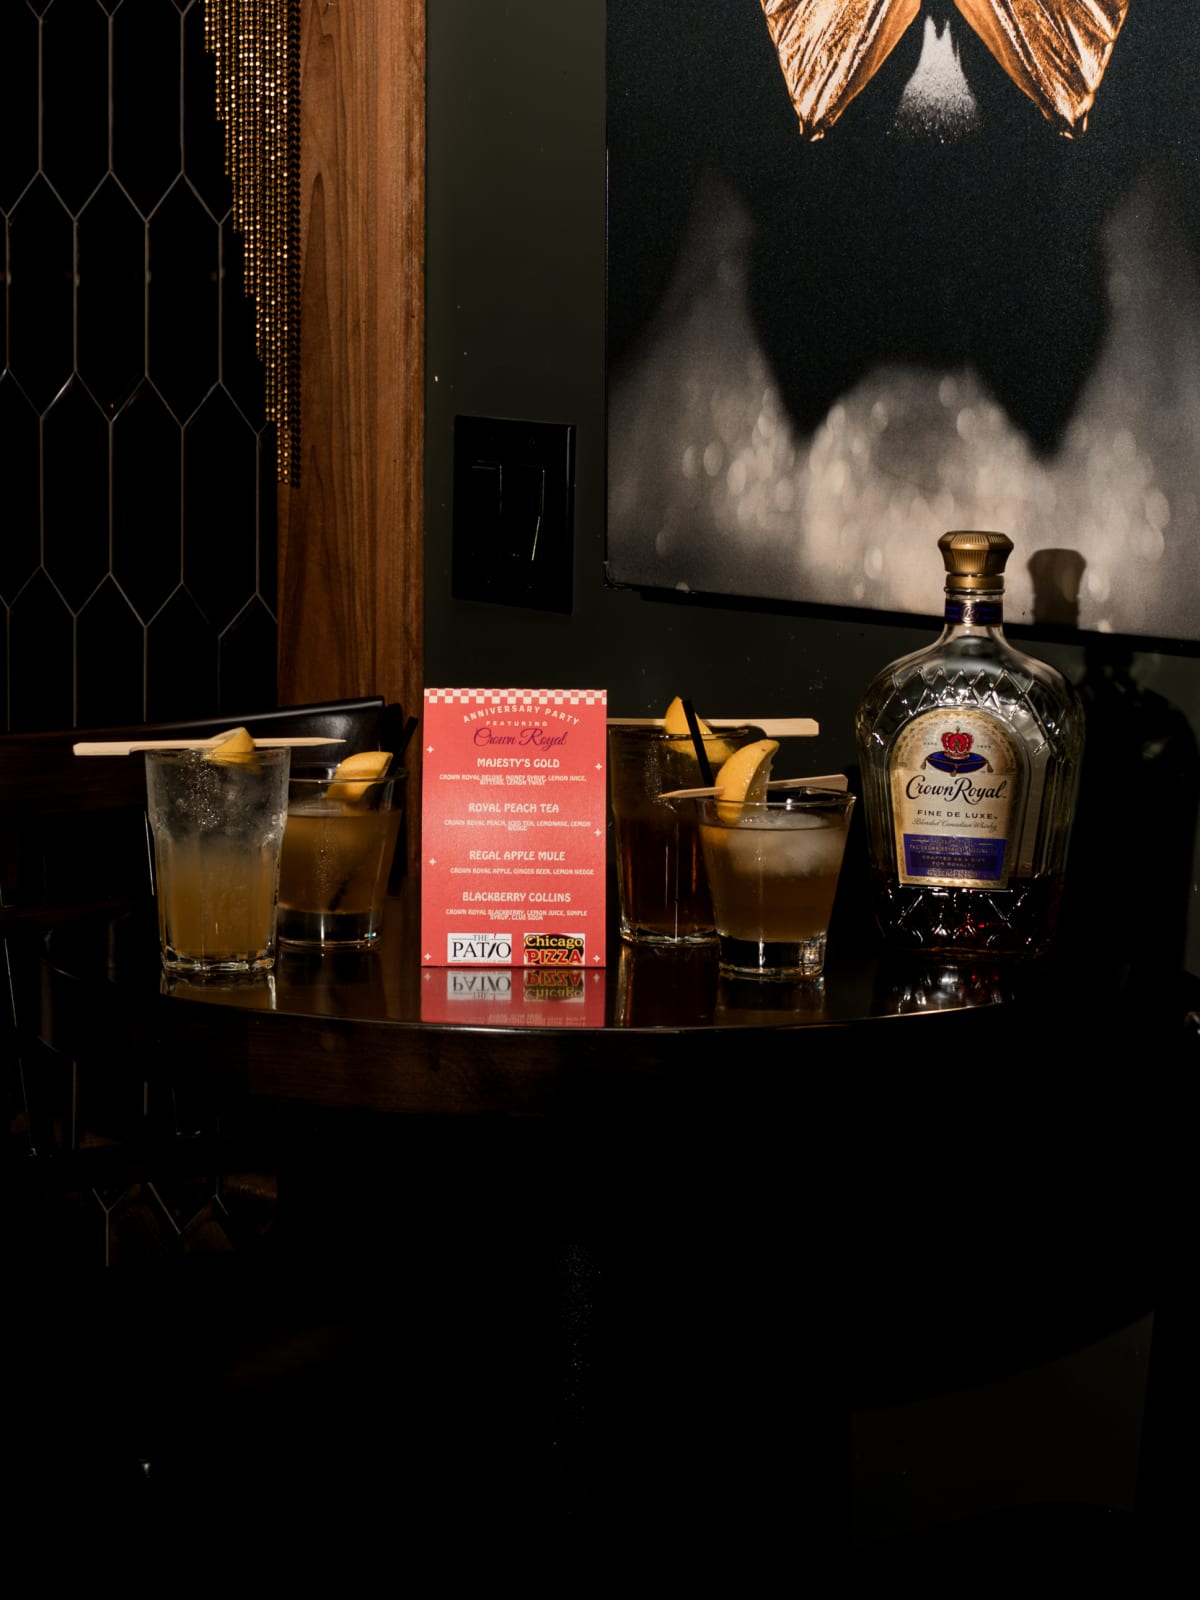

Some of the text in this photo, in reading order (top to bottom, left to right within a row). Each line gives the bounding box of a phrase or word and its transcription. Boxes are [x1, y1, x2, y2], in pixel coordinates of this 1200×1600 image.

[463, 705, 580, 725] ANNIVERSARY PARTY
[474, 728, 568, 751] Crown Royal
[477, 758, 560, 768] MAJESTY'S GOLD
[906, 775, 1007, 805] Crown Royal
[469, 803, 559, 813] ROYAL PEACH TEA
[912, 818, 998, 832] Blended Canadian Whisky
[469, 850, 565, 860] REGAL APPLE MULE
[463, 892, 571, 902] BLACKBERRY COLLINS
[524, 934, 584, 949] Chicago
[453, 941, 511, 959] PATIO
[525, 949, 582, 964] PIZZA
